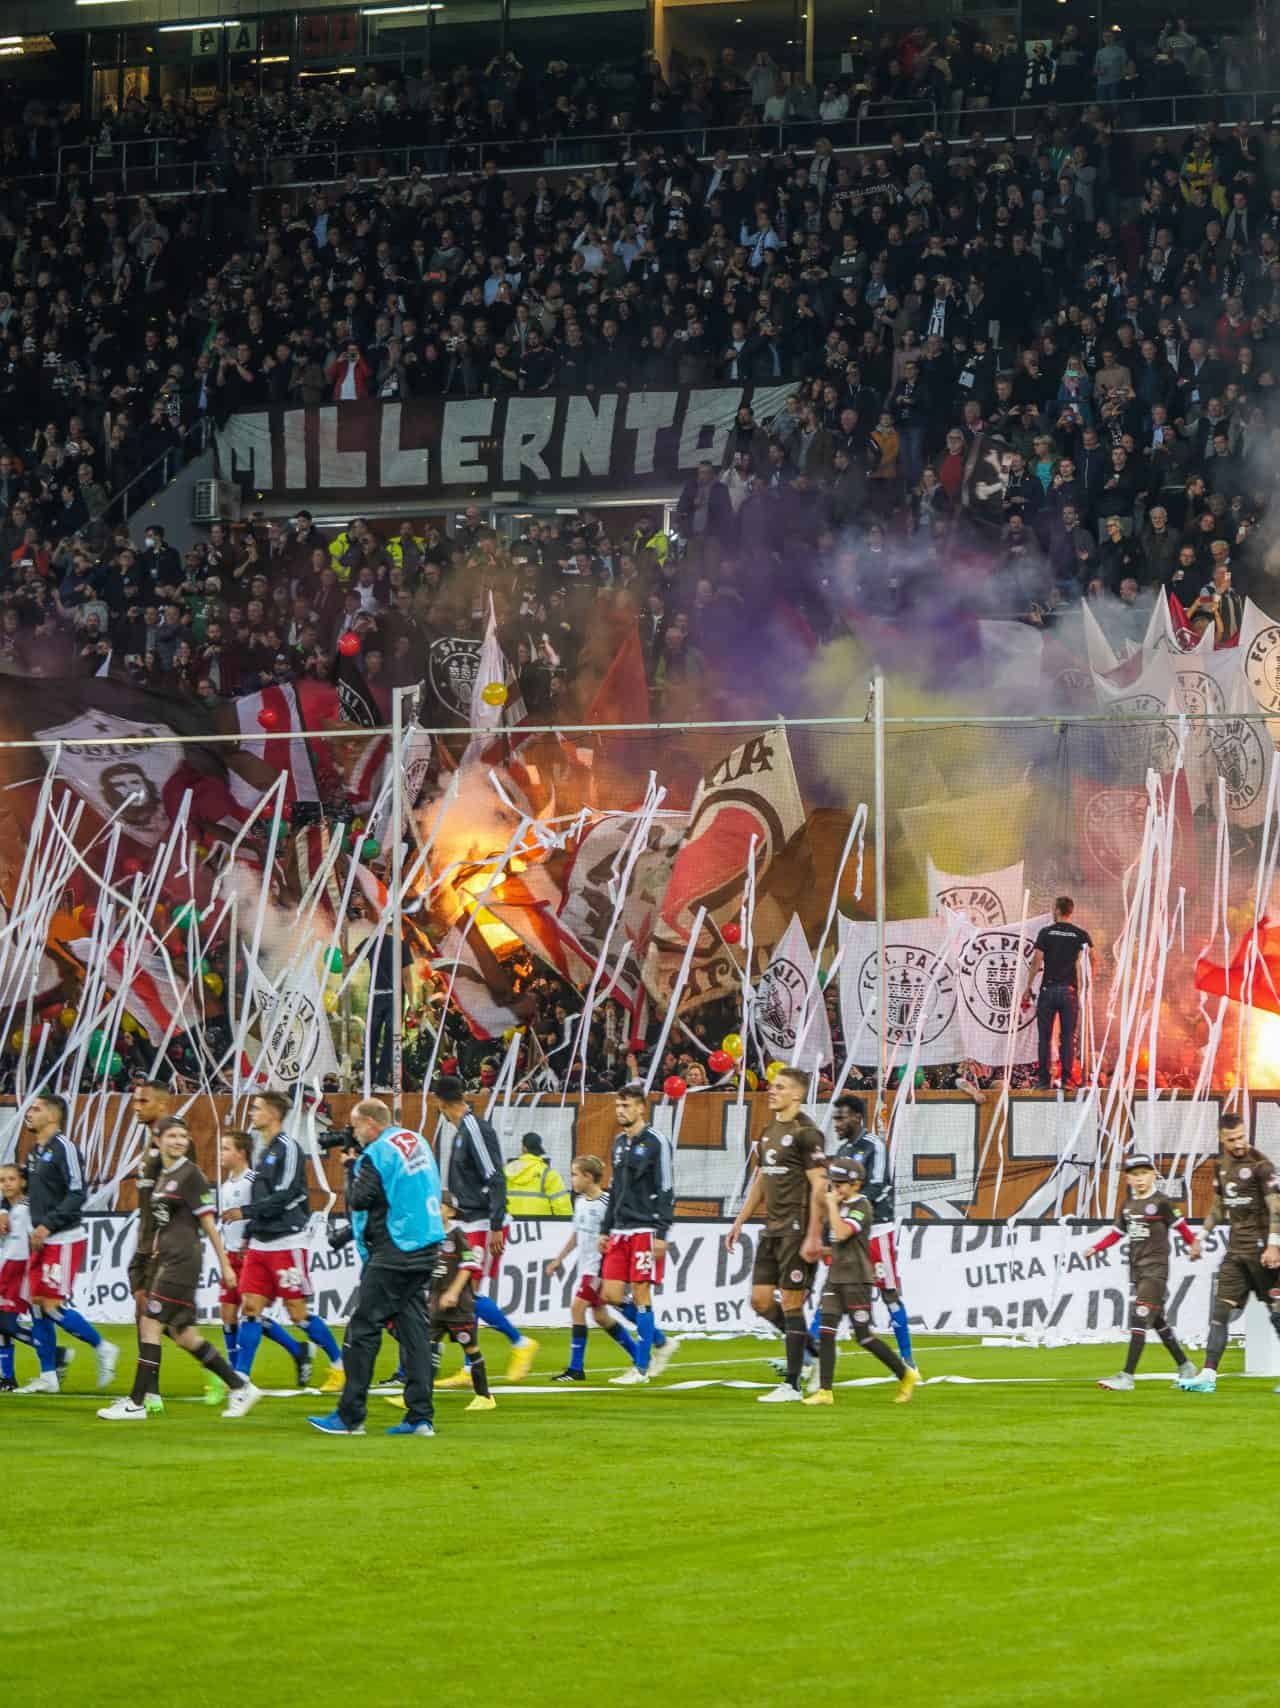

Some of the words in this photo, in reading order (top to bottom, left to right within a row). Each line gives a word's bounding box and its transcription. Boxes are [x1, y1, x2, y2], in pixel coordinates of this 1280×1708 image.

[1251, 642, 1267, 662] FC
[968, 891, 1001, 923] PAUL
[962, 956, 976, 976] FC
[975, 938, 996, 954] ST.
[310, 1246, 356, 1273] ADE
[966, 1256, 1046, 1288] ULTRA
[715, 1299, 745, 1323] BY
